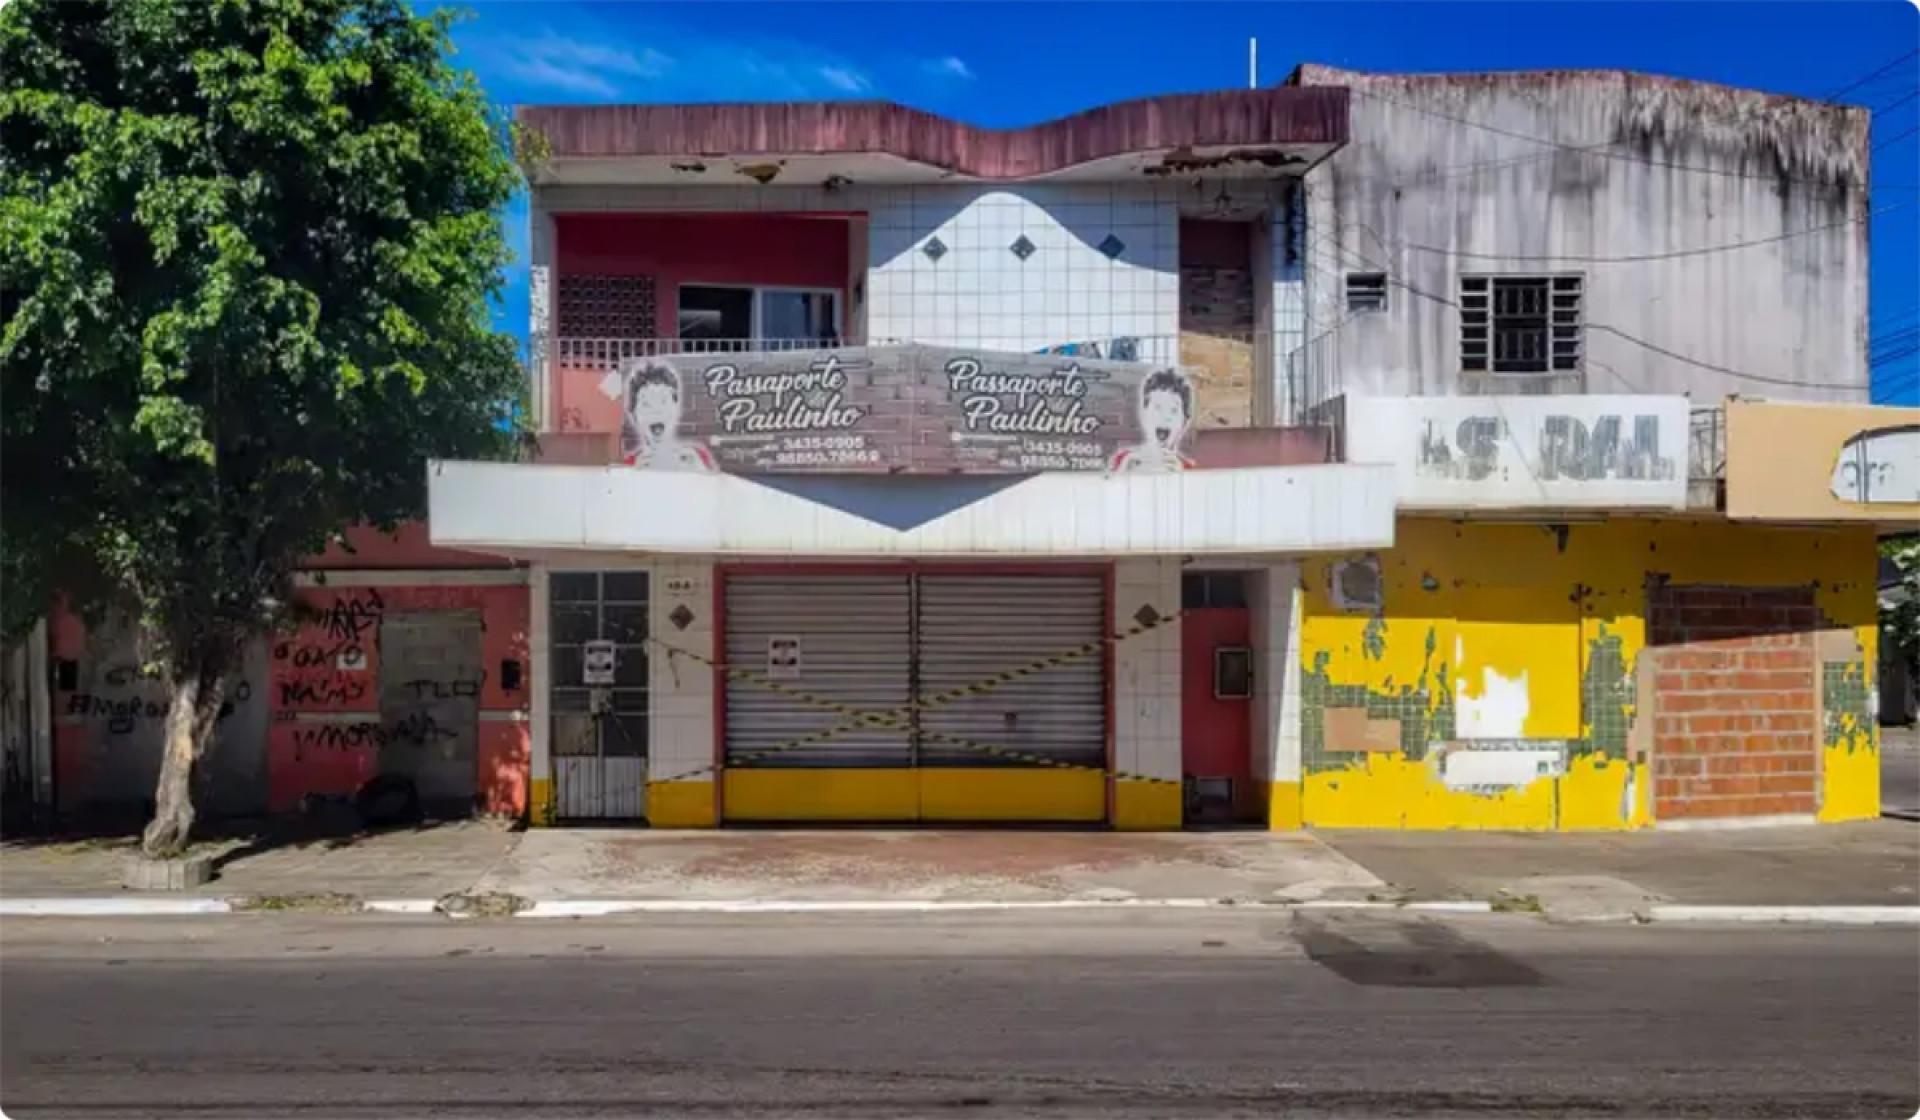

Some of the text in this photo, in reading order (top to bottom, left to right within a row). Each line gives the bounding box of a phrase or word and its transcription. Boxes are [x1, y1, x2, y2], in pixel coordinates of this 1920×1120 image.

[704, 356, 852, 406] Passaporte
[946, 359, 1089, 408] Passaporte
[719, 393, 863, 432] Paulinho
[963, 396, 1100, 435] Paulinho
